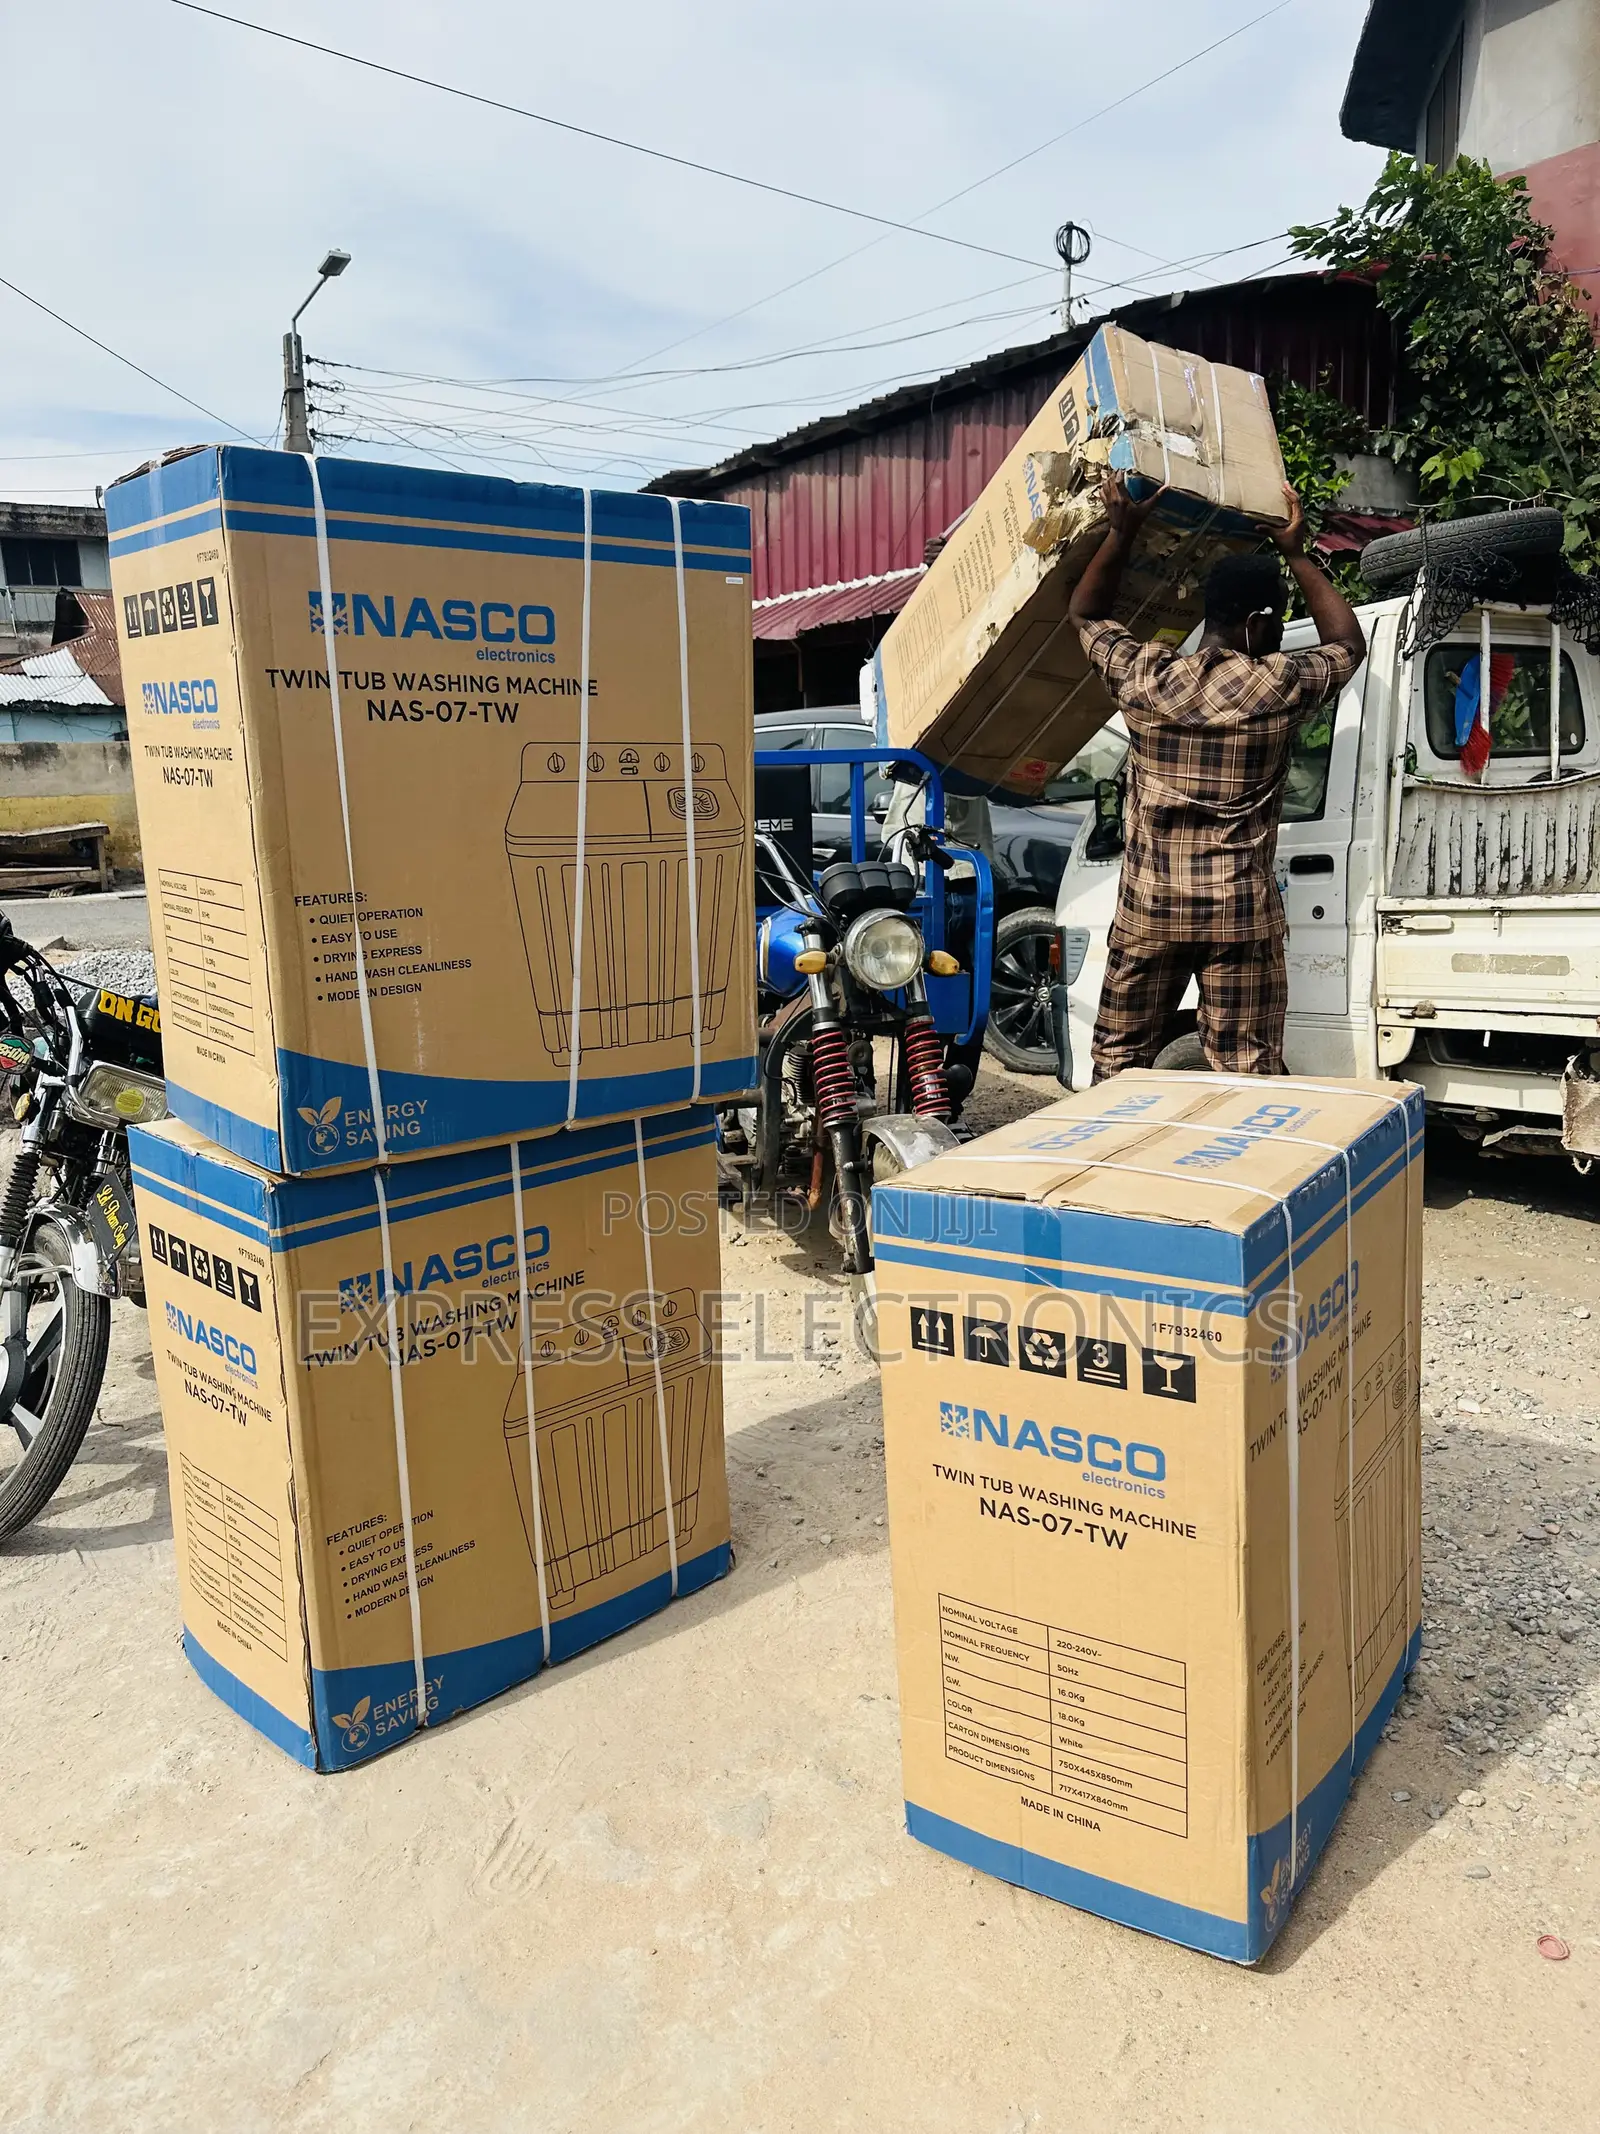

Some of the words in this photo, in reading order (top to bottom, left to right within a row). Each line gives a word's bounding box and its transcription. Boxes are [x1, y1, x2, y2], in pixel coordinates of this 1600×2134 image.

[352, 594, 555, 644] NASCO
[476, 648, 555, 664] electronics
[153, 679, 218, 715] NASCO
[265, 669, 331, 689] TWIN
[339, 671, 386, 691] TUB
[393, 672, 499, 693] WASHING
[507, 676, 598, 697] MACHINE
[192, 719, 220, 730] electronics
[368, 699, 519, 724] NAS-07-TW
[144, 745, 161, 758] TWIN
[161, 746, 173, 759] TUB
[174, 746, 203, 760] WASHING
[204, 747, 233, 761] MACHINE
[162, 766, 213, 788] NAS-07-TW
[295, 892, 368, 907] FEATURES:
[319, 912, 355, 925] QUIET
[358, 908, 423, 921] OPERATION
[322, 932, 352, 944] EASY
[375, 929, 397, 939] USE
[371, 945, 422, 959] EXPRESS
[325, 971, 358, 983] HAND
[363, 967, 395, 979] WASH
[398, 959, 472, 975] CLEANLINESS
[98, 989, 135, 1023] ON
[327, 987, 377, 1002] MODEN
[380, 982, 422, 996] DESIGN
[344, 1099, 427, 1127] ENRGY
[1027, 1104, 1150, 1151] NSCO
[97, 1184, 113, 1207] Let
[104, 1200, 120, 1230] Them
[376, 1225, 550, 1305] NASCO
[176, 1309, 257, 1375] NASCO
[304, 1344, 358, 1372] TWIN
[410, 1296, 501, 1333] WASHING
[1152, 1320, 1223, 1343] 1F7932460
[167, 1350, 182, 1369] TWIN
[183, 1362, 198, 1378] TUB
[199, 1369, 237, 1400] WASHING
[237, 1392, 272, 1422] MACHINE
[224, 1363, 259, 1389] electronics
[185, 1379, 247, 1427] NAS-07-TW
[1249, 1421, 1276, 1463] TWIN
[1279, 1409, 1289, 1431] TU
[1297, 1351, 1336, 1407] WASHING
[1297, 1367, 1344, 1436] AS-07-TW
[973, 1408, 1166, 1482] NASCO
[1082, 1471, 1166, 1499] electronics
[933, 1463, 975, 1487] TWIN
[980, 1475, 1014, 1495] TUB
[1018, 1484, 1103, 1517] WASHING
[1110, 1506, 1197, 1540] MACHINE
[326, 1514, 388, 1546] FEATURES:
[347, 1534, 377, 1554] QUIET
[379, 1510, 434, 1540] OPERTION
[980, 1497, 1128, 1551] NAS-07-TW
[349, 1552, 376, 1570] EASY
[377, 1547, 391, 1557] TO
[393, 1538, 406, 1550] US
[351, 1563, 388, 1586] DRYING
[390, 1542, 434, 1569] EXPESS
[353, 1583, 381, 1602] HAND
[415, 1539, 476, 1574] CLEANLINESS
[355, 1591, 397, 1618] MODERN
[399, 1575, 434, 1599] DEIGN
[217, 1619, 230, 1639] MADE
[942, 1605, 978, 1624] NOMINAL
[979, 1618, 1018, 1635] VOLTAGE
[943, 1629, 979, 1647] NOMINAL
[980, 1642, 1030, 1662] FREQUENCY
[1057, 1664, 1079, 1677] 50Hz
[947, 1699, 973, 1714] COLOR
[1057, 1688, 1085, 1703] 16.0Kg
[375, 1696, 439, 1737] SAVIG
[1058, 1712, 1085, 1727] 18.0Kg
[948, 1721, 980, 1739] CARTON
[981, 1735, 1030, 1756] DIMENSIONS
[1058, 1736, 1083, 1749] White
[948, 1744, 984, 1764] PRODUCT
[986, 1760, 1035, 1781] DIMENSIONS
[1058, 1760, 1133, 1789] 750X445X850mm
[1058, 1784, 1129, 1812] 717X417X840mm
[1020, 1796, 1050, 1815] MADE
[1053, 1808, 1064, 1820] IN
[1066, 1813, 1101, 1832] CHINA
[1280, 1818, 1312, 1888] ENRGY
